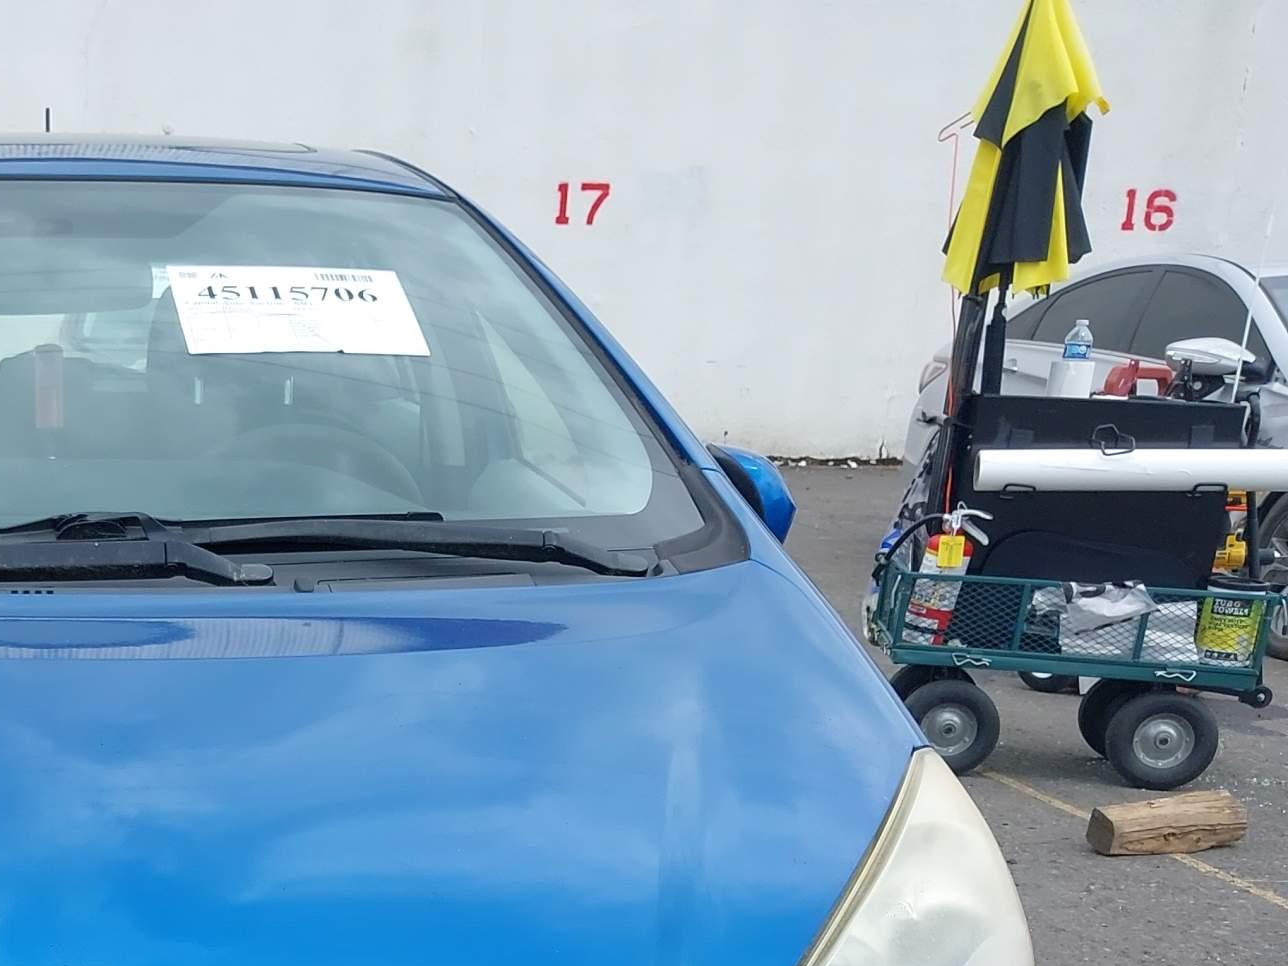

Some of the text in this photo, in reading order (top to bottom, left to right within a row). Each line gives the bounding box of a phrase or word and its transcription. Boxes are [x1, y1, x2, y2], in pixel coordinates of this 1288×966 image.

[554, 182, 611, 226] 17
[1120, 188, 1176, 233] 16
[197, 285, 379, 303] 45115706
